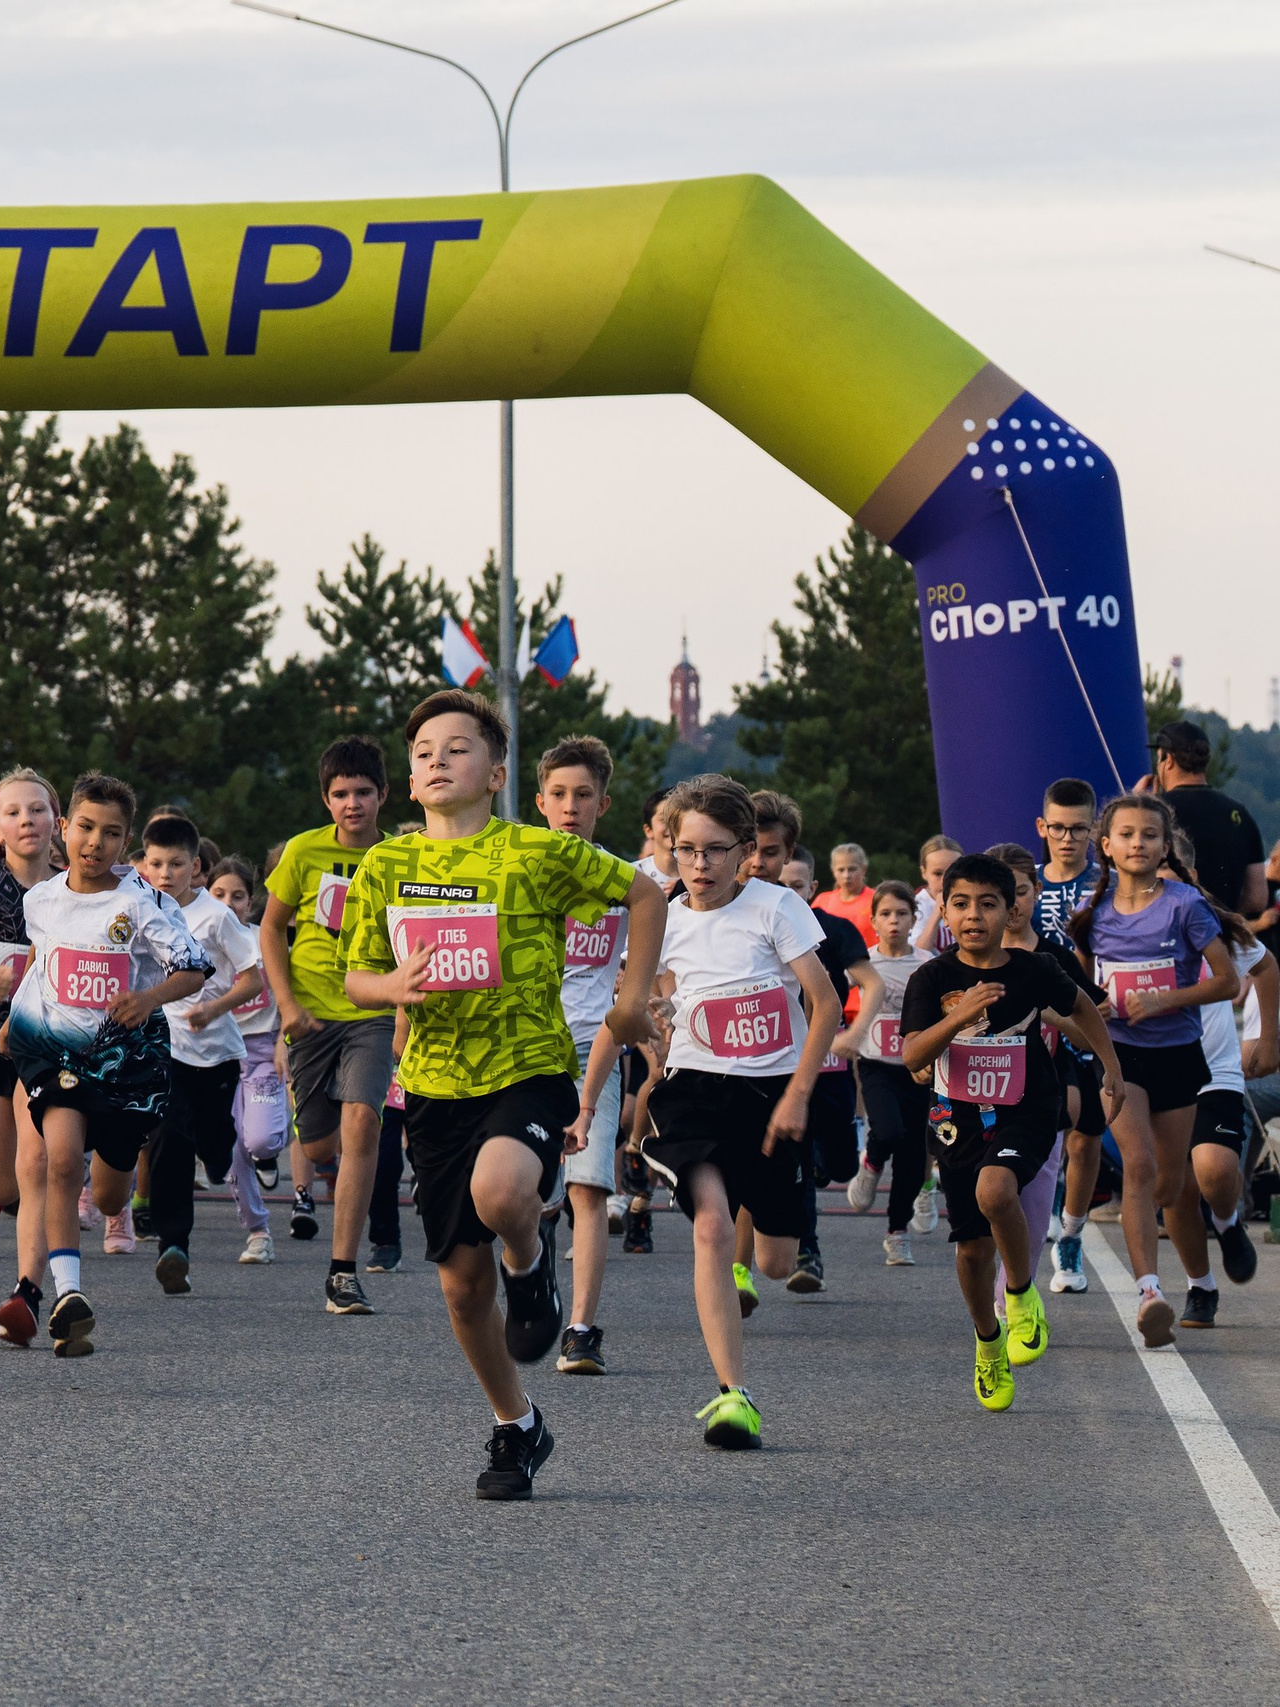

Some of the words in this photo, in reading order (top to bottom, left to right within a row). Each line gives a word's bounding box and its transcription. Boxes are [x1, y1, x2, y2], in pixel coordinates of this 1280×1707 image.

[926, 582, 967, 607] PRO
[929, 596, 1067, 643] СПОРТ
[1076, 594, 1120, 628] 40
[402, 885, 441, 897] FREE
[441, 887, 473, 899] NRG
[437, 928, 468, 945] ГЛЕБ
[565, 931, 611, 958] 4206
[76, 959, 110, 975] ДАВИД
[67, 973, 120, 1003] 3203
[1136, 973, 1154, 986] ЯНА
[735, 999, 761, 1016] ОЛЕГ
[723, 1011, 780, 1048] 4667
[968, 1054, 1012, 1068] АРСЕНИЙ
[967, 1070, 1011, 1098] 907
